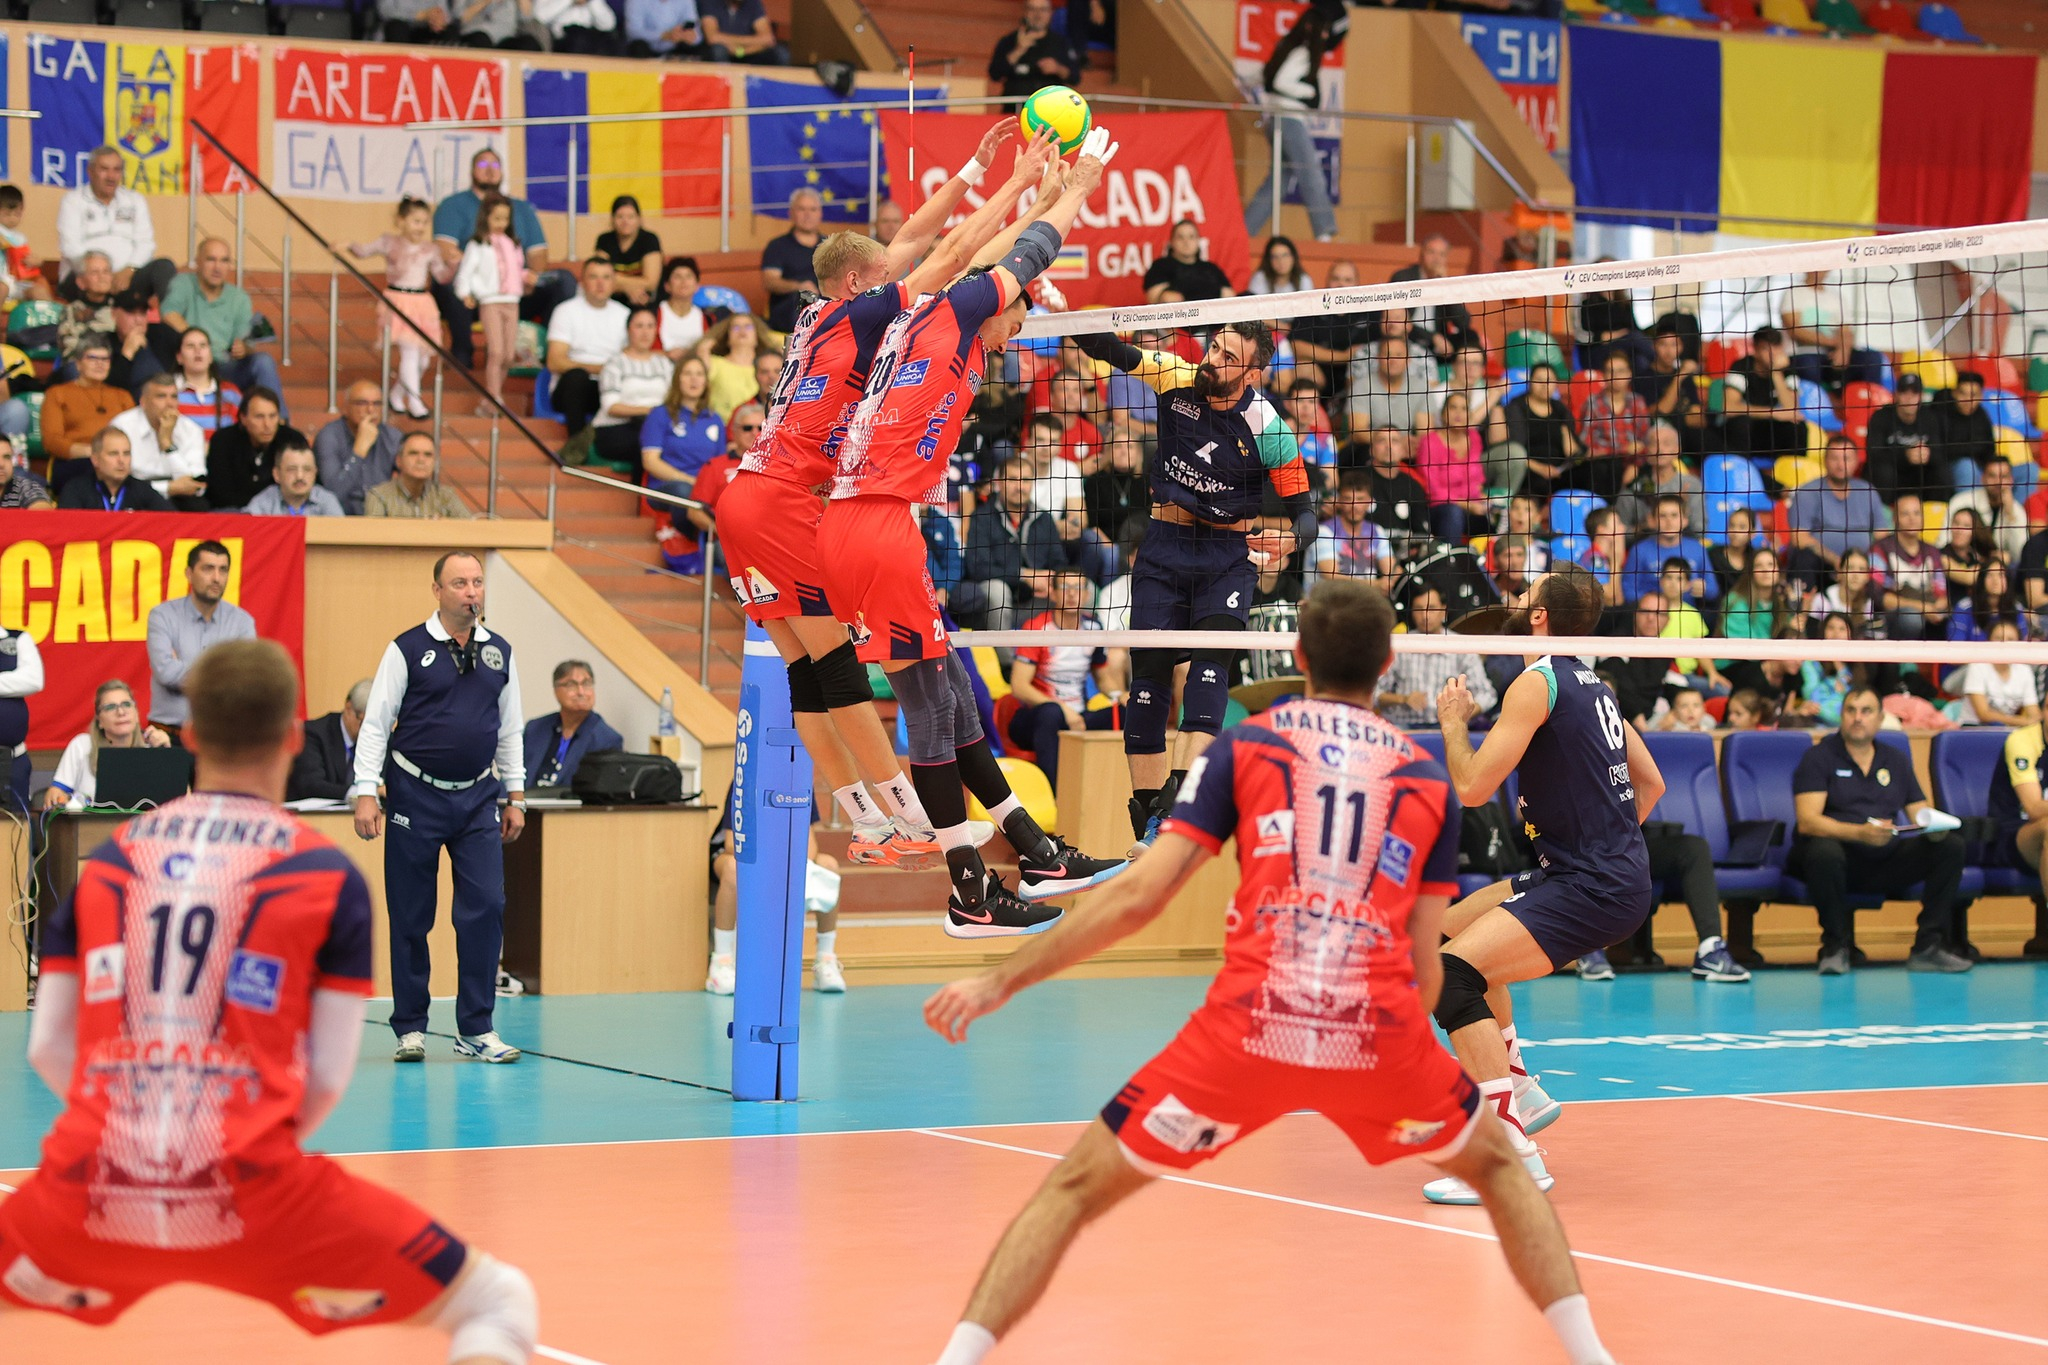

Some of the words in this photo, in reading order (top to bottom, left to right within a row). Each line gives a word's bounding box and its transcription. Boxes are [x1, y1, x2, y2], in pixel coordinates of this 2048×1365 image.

[288, 130, 494, 194] GALAT
[1863, 246, 1877, 256] CEV
[1879, 243, 1916, 256] Champions
[1918, 242, 1942, 253] League
[1944, 238, 1964, 249] Volley
[1966, 236, 1983, 246] 2023
[1578, 274, 1591, 282] CEV
[1592, 271, 1623, 282] Champions
[1624, 270, 1645, 280] League
[1646, 266, 1664, 277] Volley
[1666, 264, 1680, 274] 2023
[1334, 296, 1345, 304] CEV
[1346, 294, 1373, 304] Champions
[1374, 293, 1392, 302] League
[1393, 290, 1408, 301] Volley
[1410, 288, 1422, 298] 2023
[1122, 315, 1132, 323] CEV
[1132, 312, 1156, 323] Champions
[1157, 312, 1173, 321] League
[1174, 310, 1187, 319] Volley
[1188, 308, 1200, 317] 2023
[861, 350, 897, 402] 20
[896, 373, 922, 382] UNIQA
[1227, 591, 1239, 608] 6
[1595, 694, 1624, 750] 18
[1275, 711, 1412, 757] MALESCHA
[734, 741, 748, 854] Senoh
[851, 791, 866, 813] MIKASA
[890, 786, 906, 808] MIKASA
[1316, 784, 1367, 865] 11
[149, 901, 216, 997] 19
